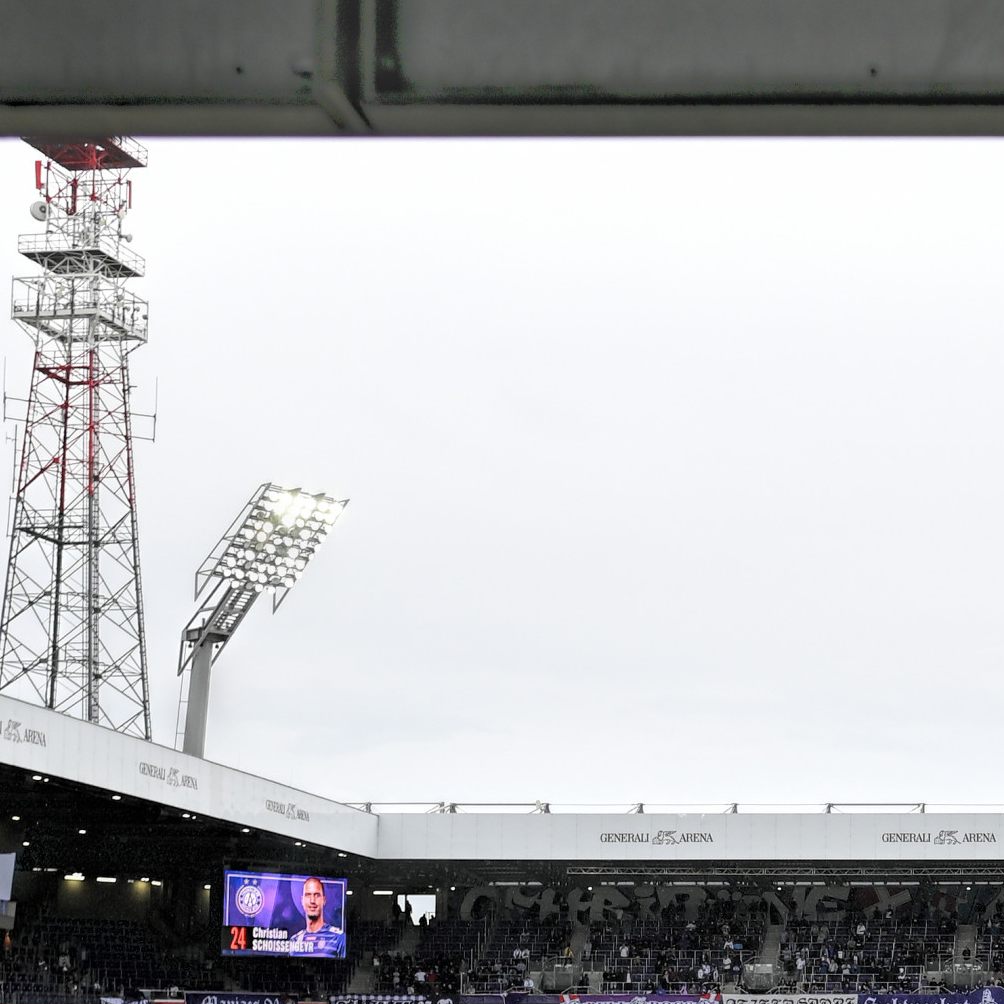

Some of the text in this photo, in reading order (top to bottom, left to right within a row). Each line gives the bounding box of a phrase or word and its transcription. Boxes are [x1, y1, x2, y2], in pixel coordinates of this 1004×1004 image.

[23, 728, 47, 748] ARENA
[138, 761, 199, 791] GENERALI ARENA
[600, 832, 714, 843] GENERALI ARENA
[881, 832, 997, 843] GENERALI ARENA
[230, 926, 288, 950] 24 Christian
